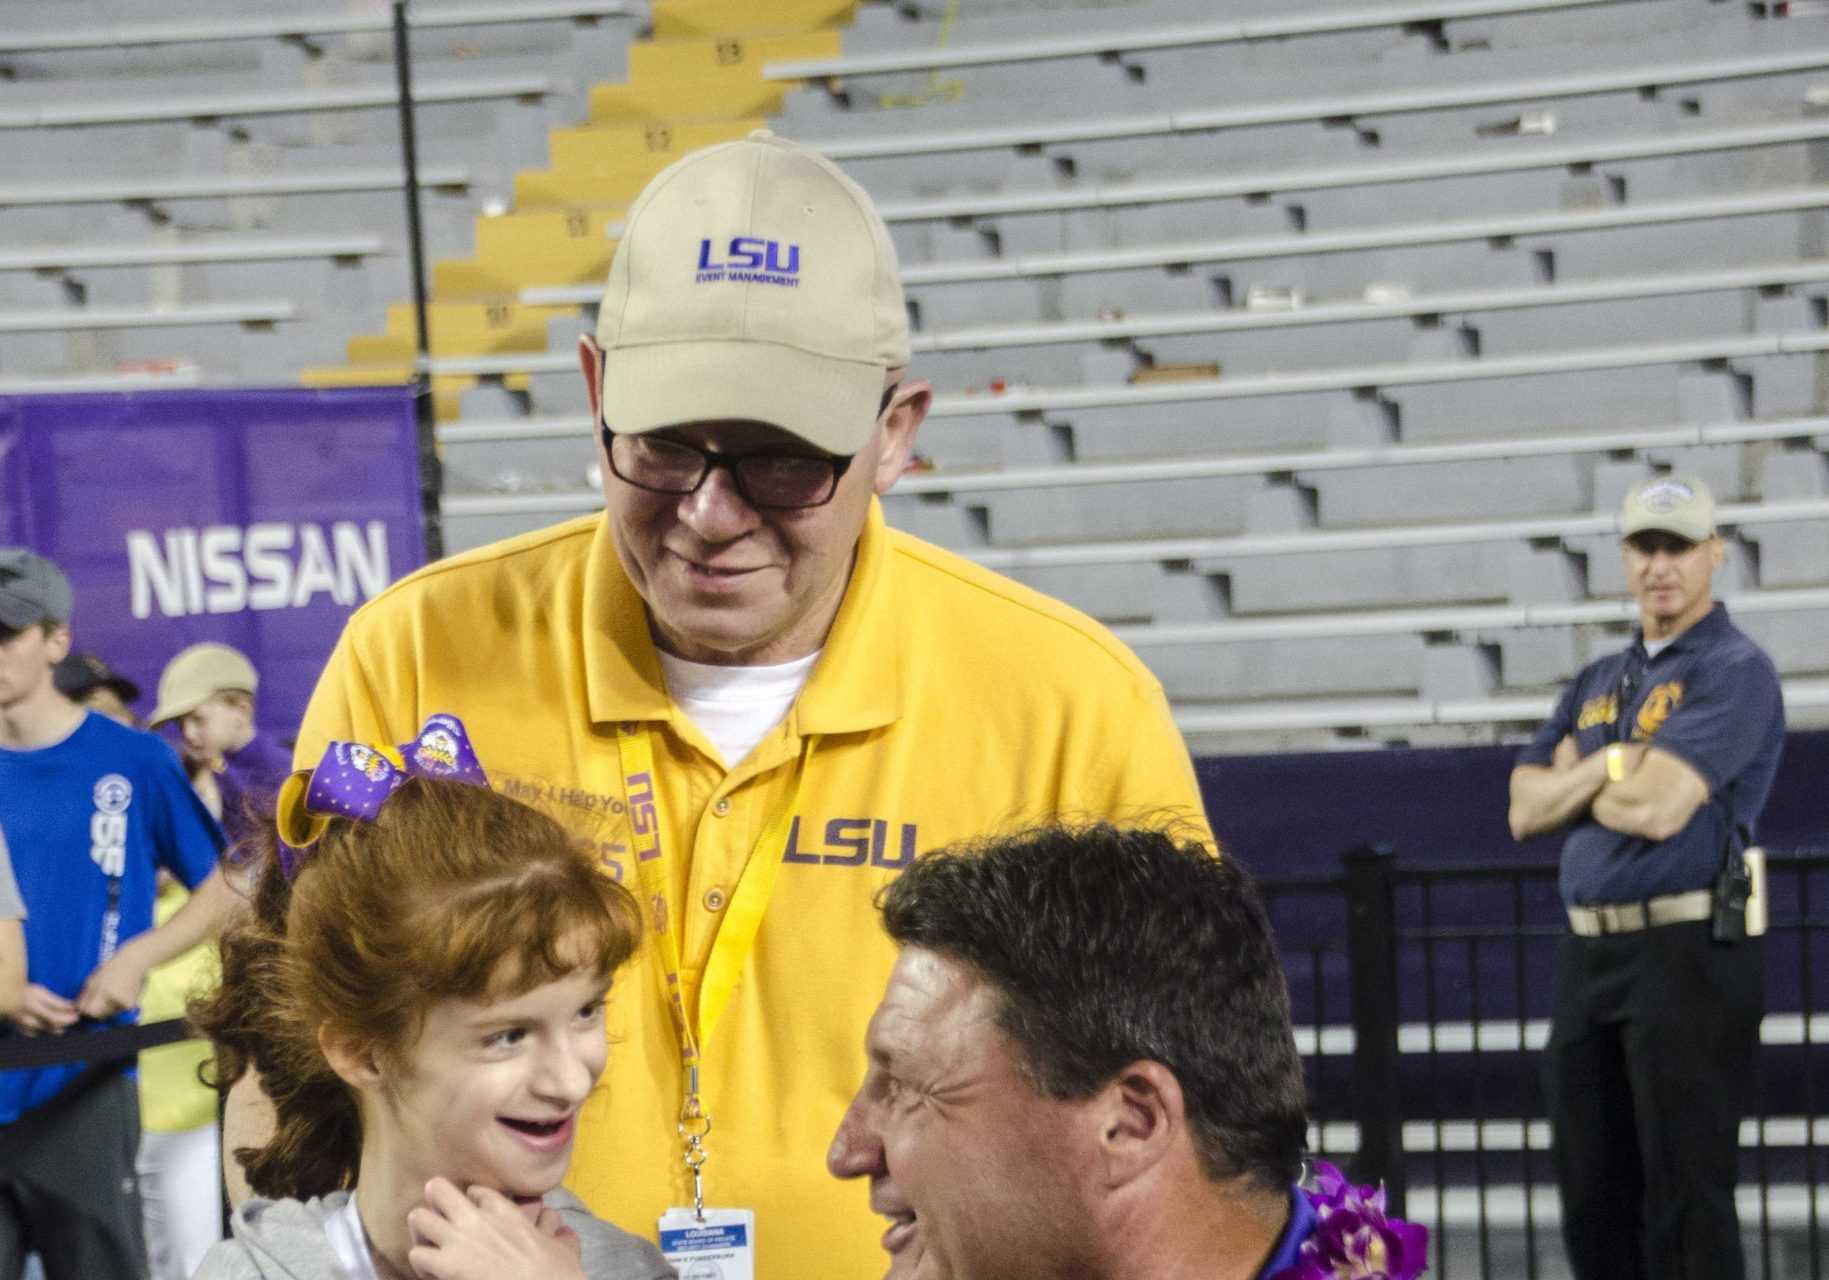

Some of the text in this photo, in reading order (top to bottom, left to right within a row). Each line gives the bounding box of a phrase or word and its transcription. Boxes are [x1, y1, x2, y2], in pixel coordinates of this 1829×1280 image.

[696, 271, 799, 288] EVENT MANAGEMENT
[698, 237, 799, 274] LSU
[126, 520, 391, 619] NISSAN
[626, 770, 662, 862] LSU
[782, 815, 917, 870] LSU
